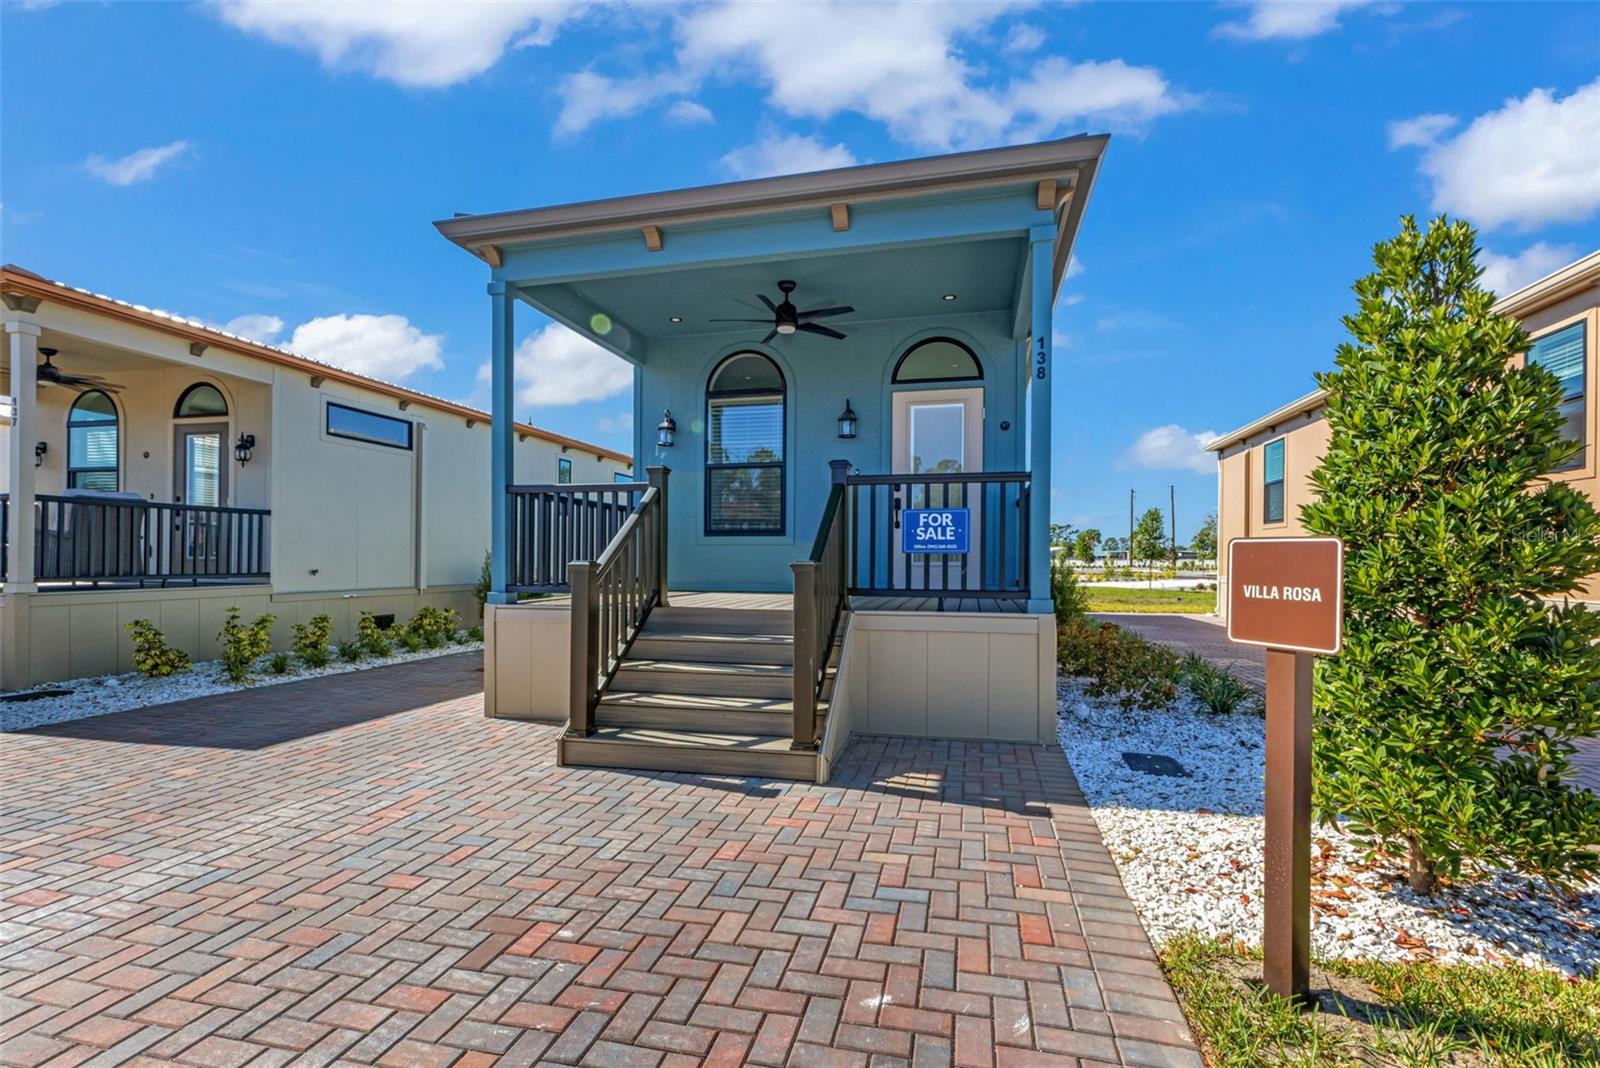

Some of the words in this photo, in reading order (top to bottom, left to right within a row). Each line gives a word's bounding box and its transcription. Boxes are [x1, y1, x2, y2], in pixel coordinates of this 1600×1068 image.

[1036, 336, 1046, 380] 138
[919, 513, 953, 527] FOR
[916, 527, 956, 540] SALE
[1243, 584, 1280, 600] VILLA
[1282, 586, 1323, 602] ROSA
